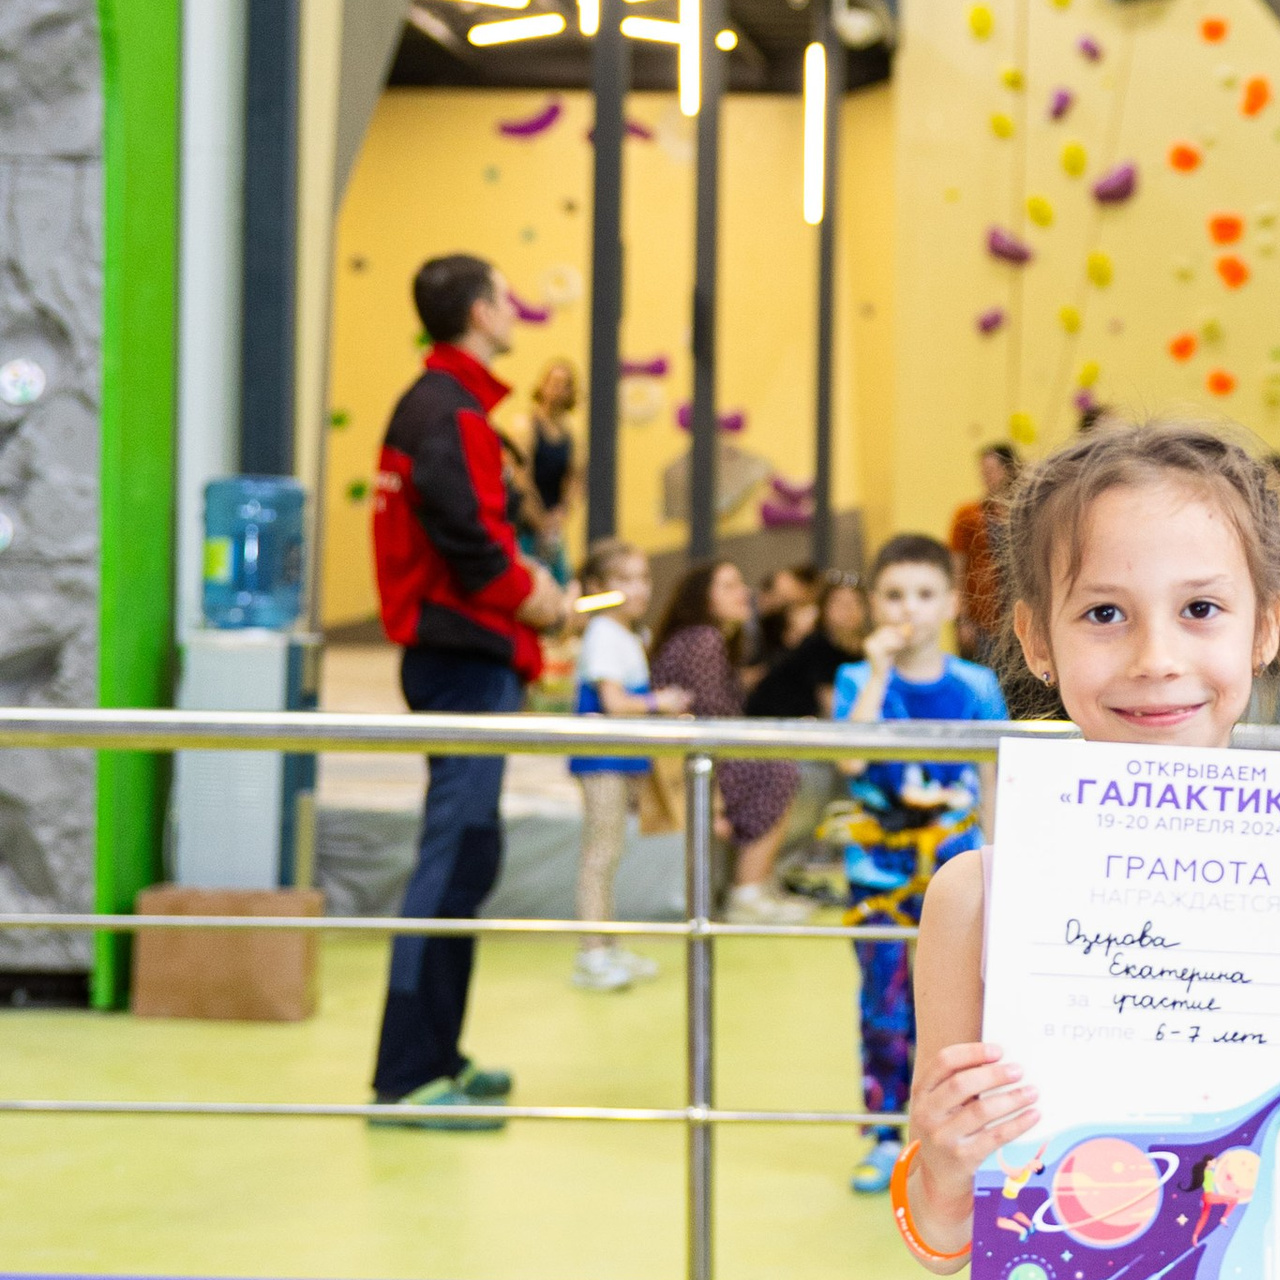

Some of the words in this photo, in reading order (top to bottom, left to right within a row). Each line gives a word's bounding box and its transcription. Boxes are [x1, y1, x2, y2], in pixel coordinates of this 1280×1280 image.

[1126, 759, 1267, 782] ОТКРЫВАЕМ
[1097, 813, 1149, 830] 19-20
[1155, 816, 1235, 835] АПРЕЛЯ
[1106, 854, 1271, 886] ГРАМОТА
[1065, 918, 1181, 956] Озерова
[1109, 952, 1253, 993] Екатерина
[1067, 993, 1090, 1008] за
[1112, 992, 1222, 1014] участие
[1062, 1024, 1135, 1042] группе
[1213, 1030, 1268, 1045] лет
